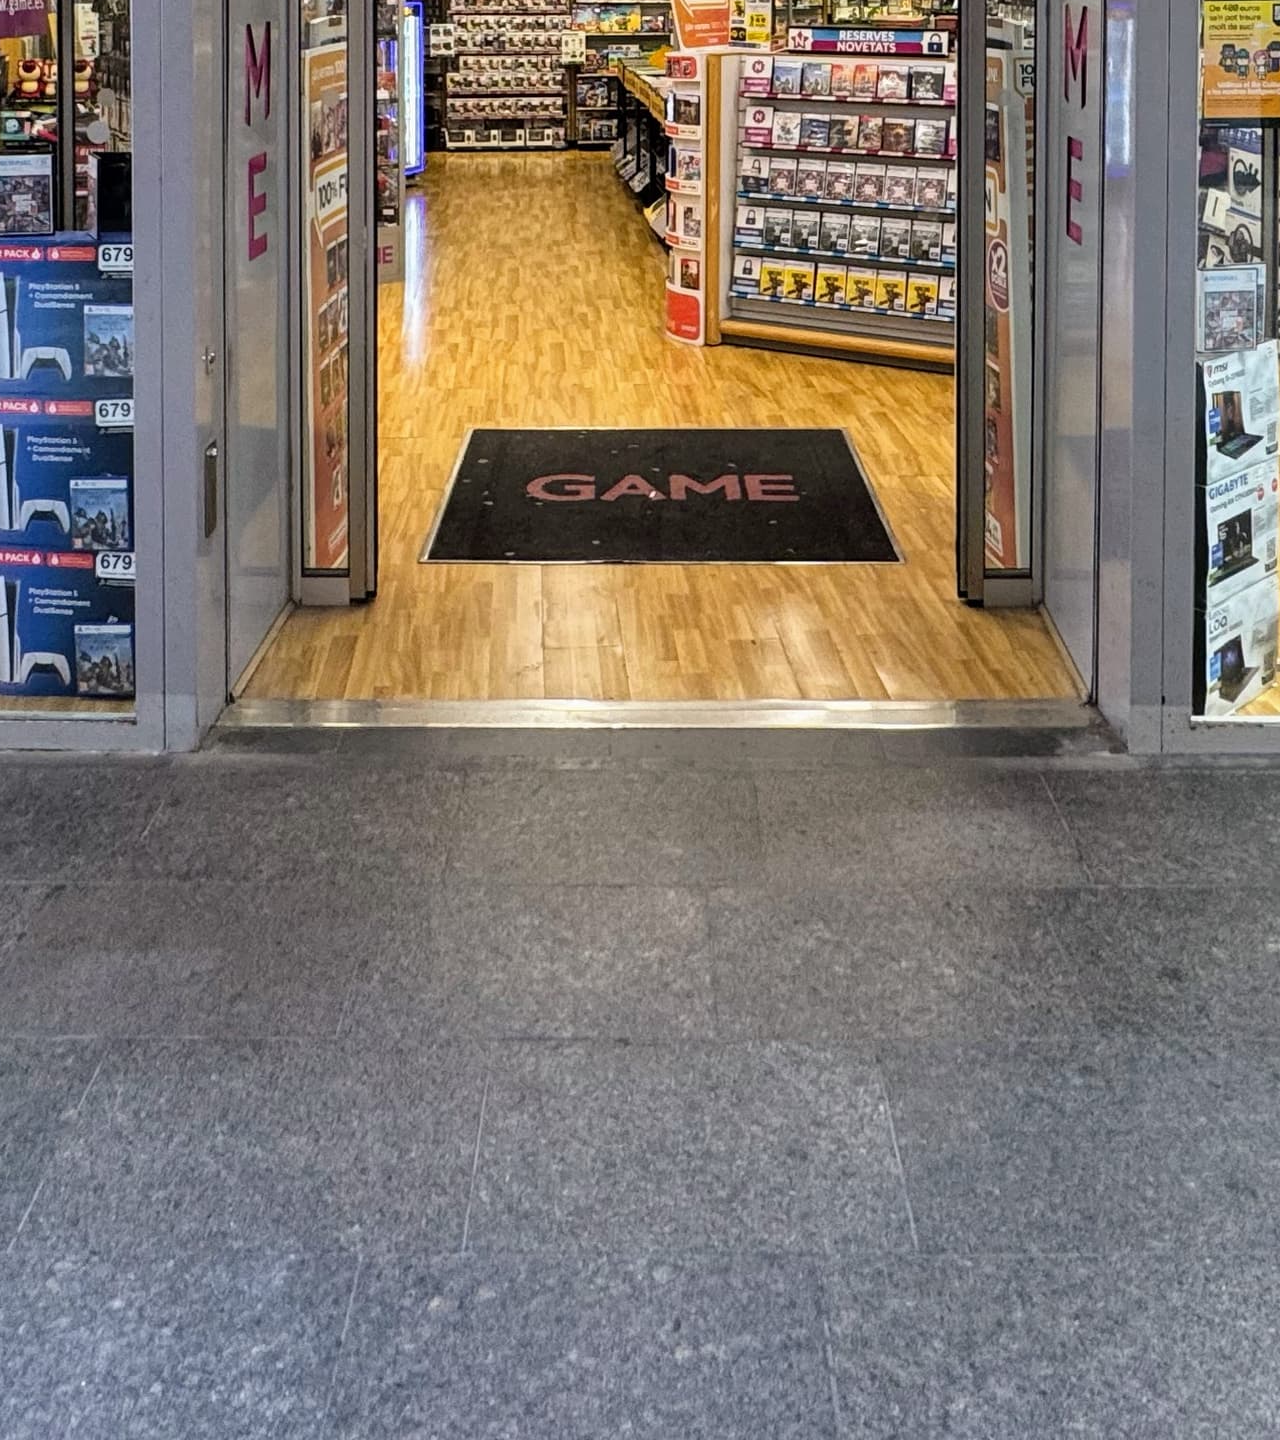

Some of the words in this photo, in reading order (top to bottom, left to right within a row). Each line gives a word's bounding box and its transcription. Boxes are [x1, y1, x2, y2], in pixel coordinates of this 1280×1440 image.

[839, 30, 894, 41] RESERVES
[837, 41, 896, 52] NOVETATS
[3, 248, 29, 258] PACK
[101, 248, 133, 262] 679
[3, 401, 28, 410] PACK
[99, 402, 131, 417] 679
[525, 473, 800, 503] GAME
[1208, 473, 1249, 500] GIGABYTE
[5, 553, 30, 562] PACK
[100, 554, 132, 570] 679
[1209, 615, 1228, 634] LOQ
